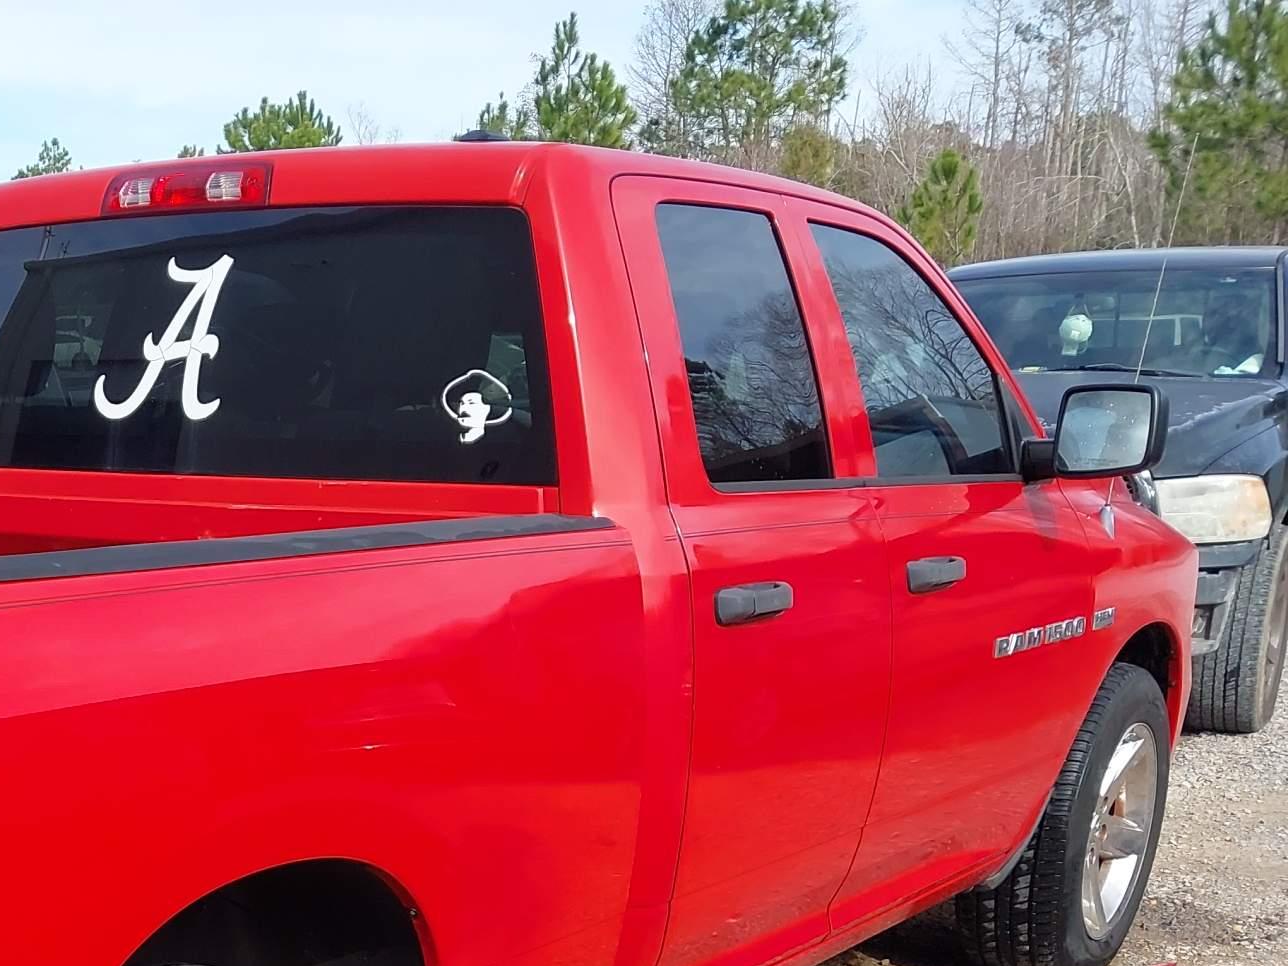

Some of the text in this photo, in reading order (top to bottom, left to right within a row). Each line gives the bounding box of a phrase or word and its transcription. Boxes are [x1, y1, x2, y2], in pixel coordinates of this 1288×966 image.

[93, 254, 235, 420] A
[994, 616, 1087, 659] RAM 1500
